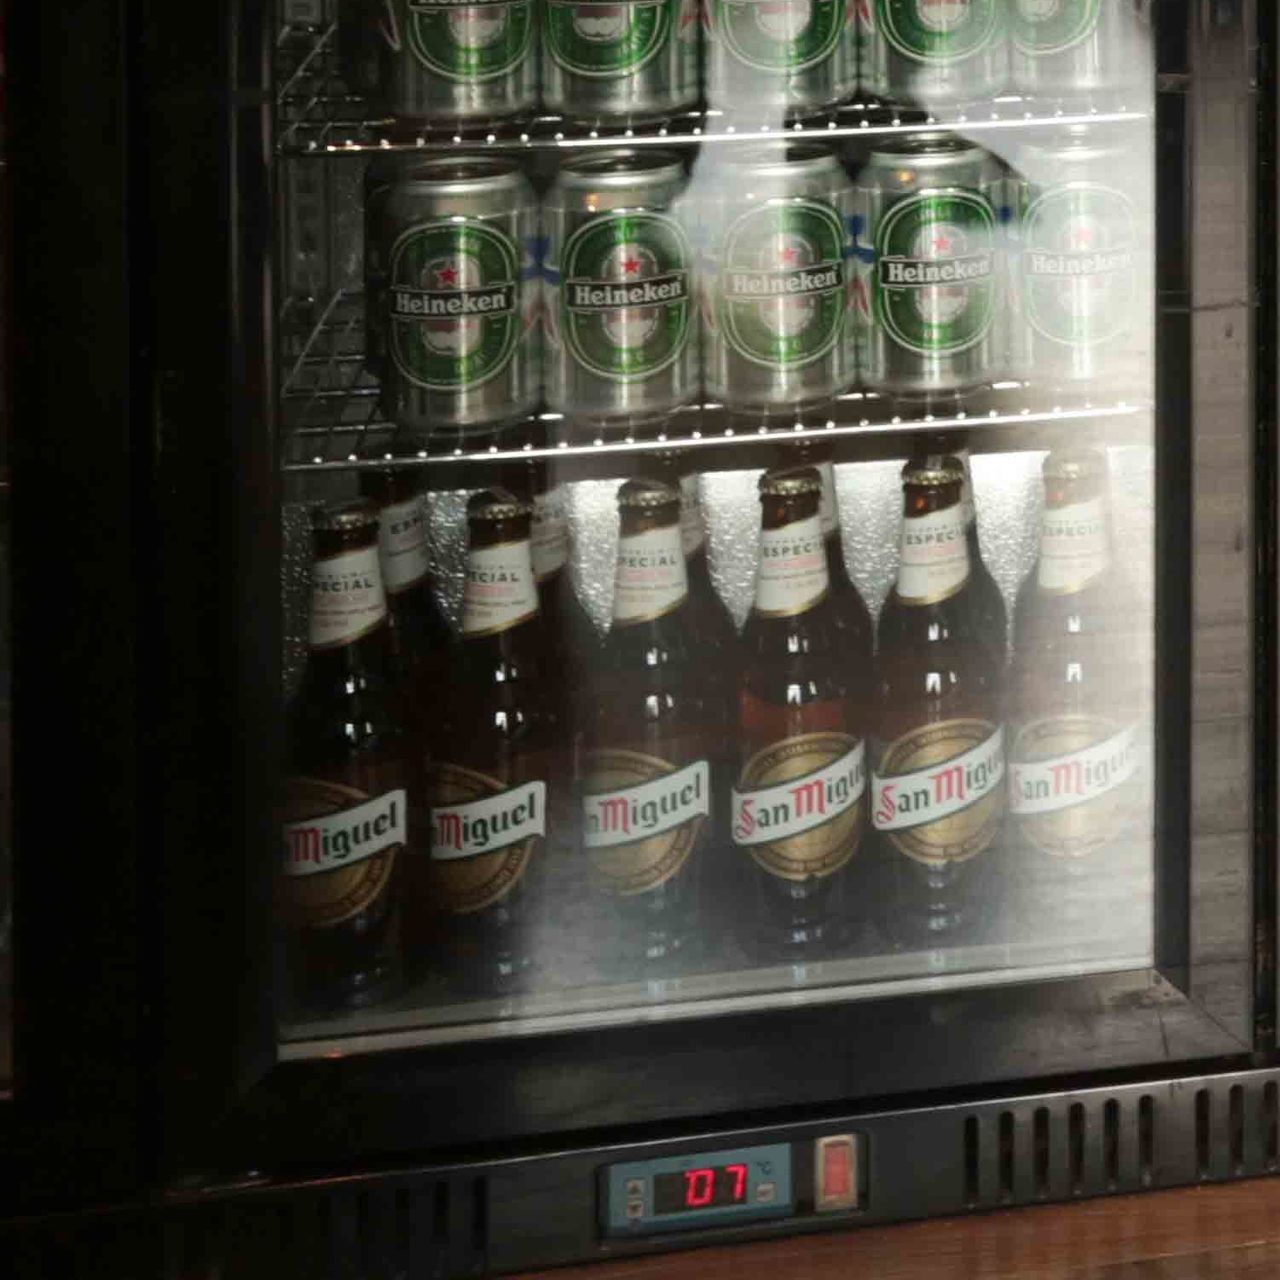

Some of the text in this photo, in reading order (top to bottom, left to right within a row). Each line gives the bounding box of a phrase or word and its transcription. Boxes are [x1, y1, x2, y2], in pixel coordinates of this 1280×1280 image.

[733, 269, 837, 295] Heineken
[887, 258, 993, 283] Heineken
[396, 287, 507, 316] Heineken
[574, 280, 682, 306] Heineken
[437, 792, 537, 851] Miguel
[601, 772, 702, 836] Miguel
[733, 798, 791, 840] San
[875, 785, 931, 826] San
[288, 800, 398, 865] Miguel
[683, 1163, 748, 1207] 07
